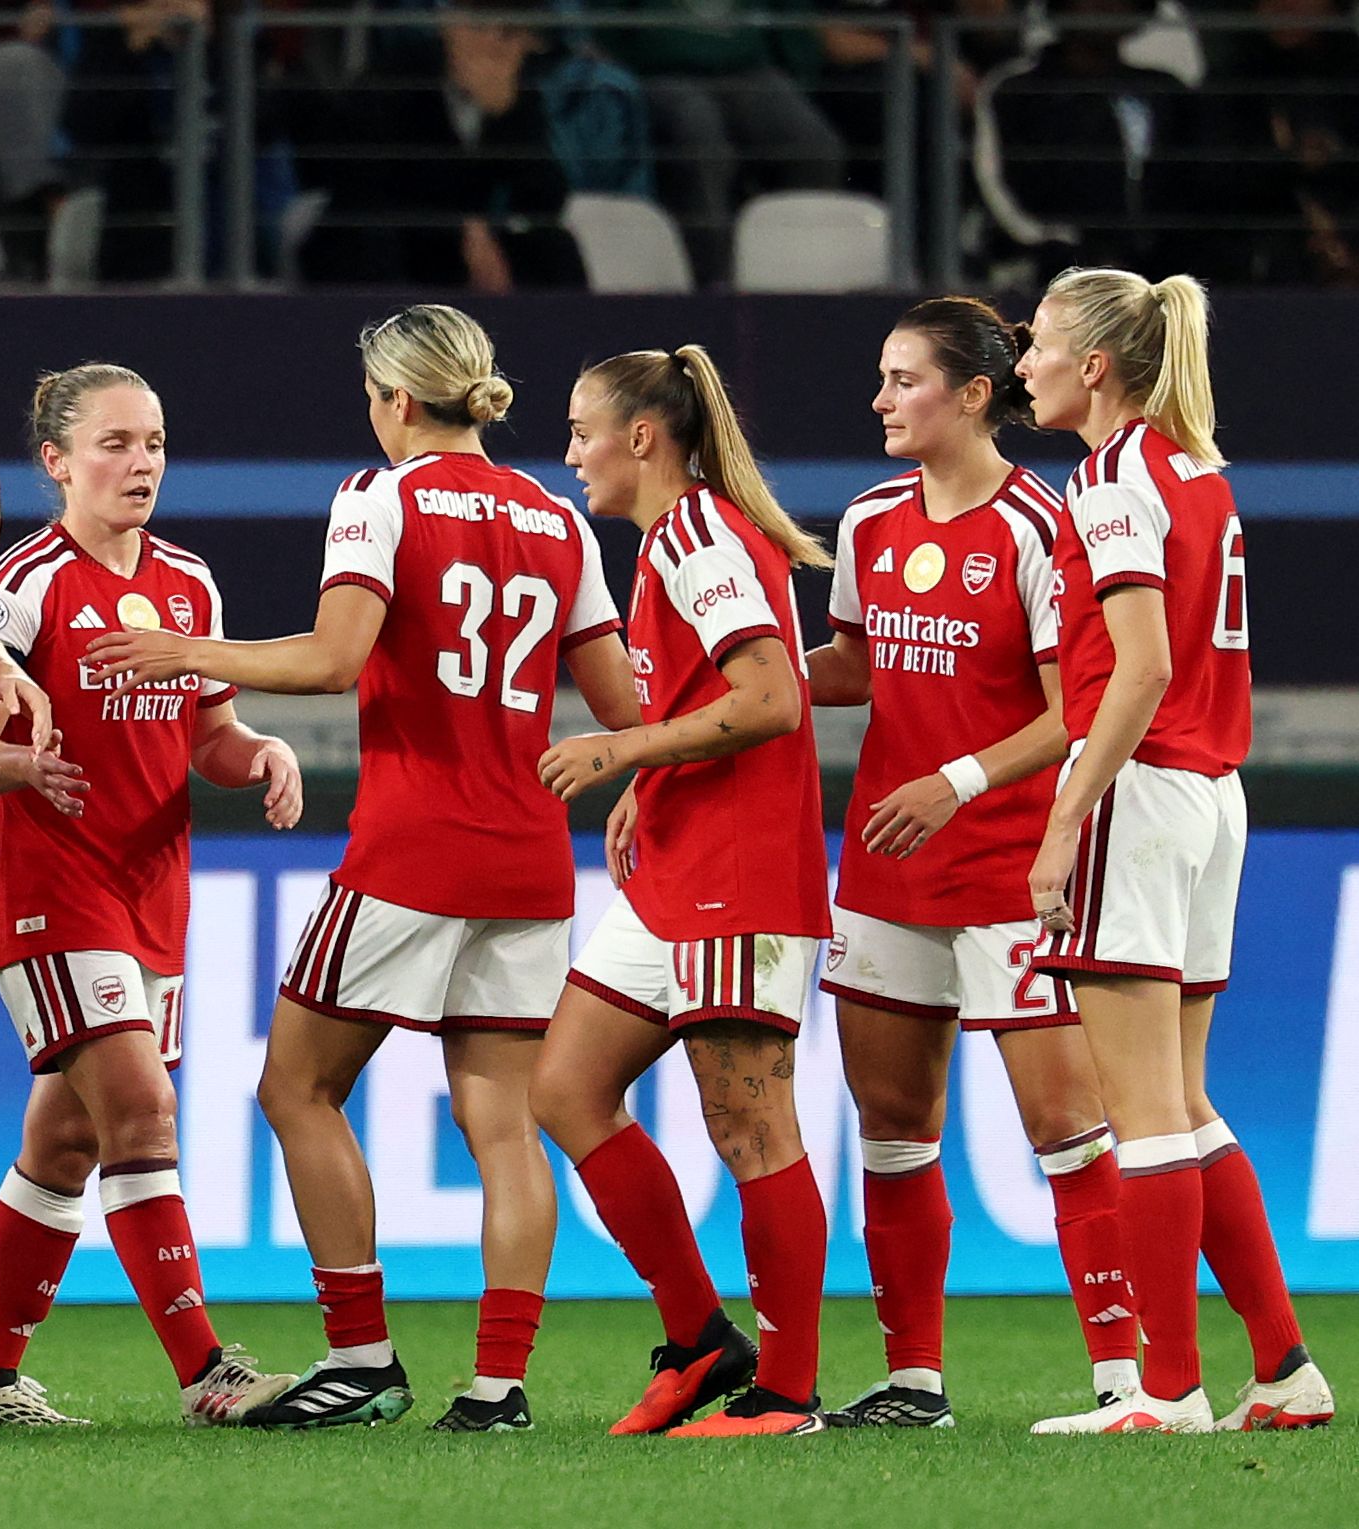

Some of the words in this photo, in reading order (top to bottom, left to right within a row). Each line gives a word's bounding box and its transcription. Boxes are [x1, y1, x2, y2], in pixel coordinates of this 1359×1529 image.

[328, 520, 373, 549] eel.
[413, 488, 569, 541] COONEY-CROSS
[692, 576, 745, 617] deel.
[436, 560, 559, 713] 32
[865, 603, 980, 648] Emirates
[875, 642, 899, 670] FLY
[902, 645, 955, 677] BETTER
[101, 694, 132, 720] FLY
[133, 694, 185, 720] BETTER
[1007, 939, 1050, 1012] 2
[1084, 1269, 1123, 1285] AFC
